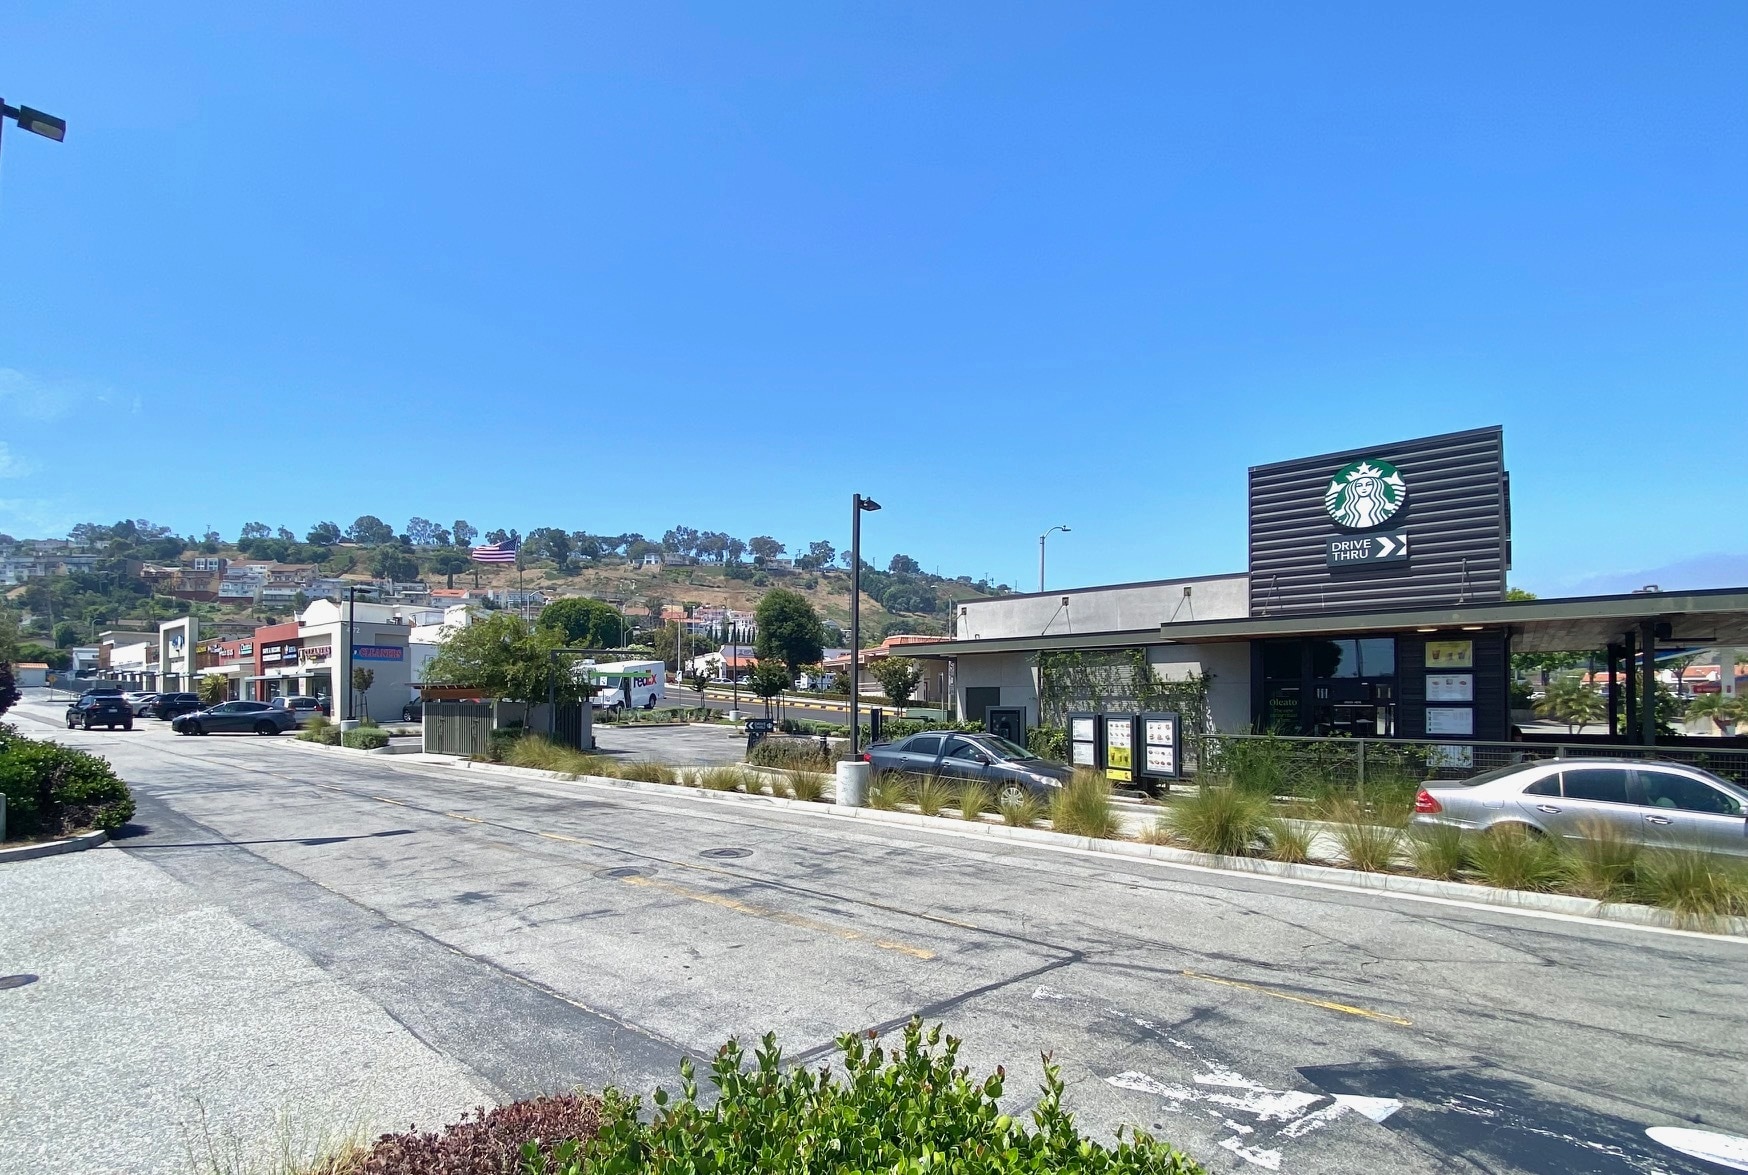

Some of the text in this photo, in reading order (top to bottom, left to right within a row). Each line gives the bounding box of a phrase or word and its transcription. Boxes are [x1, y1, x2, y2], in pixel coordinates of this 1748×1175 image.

[1331, 539, 1371, 551] DRIVE
[1331, 549, 1369, 561] THRU
[359, 648, 402, 658] CLEANERS
[1269, 698, 1298, 706] Oleato
